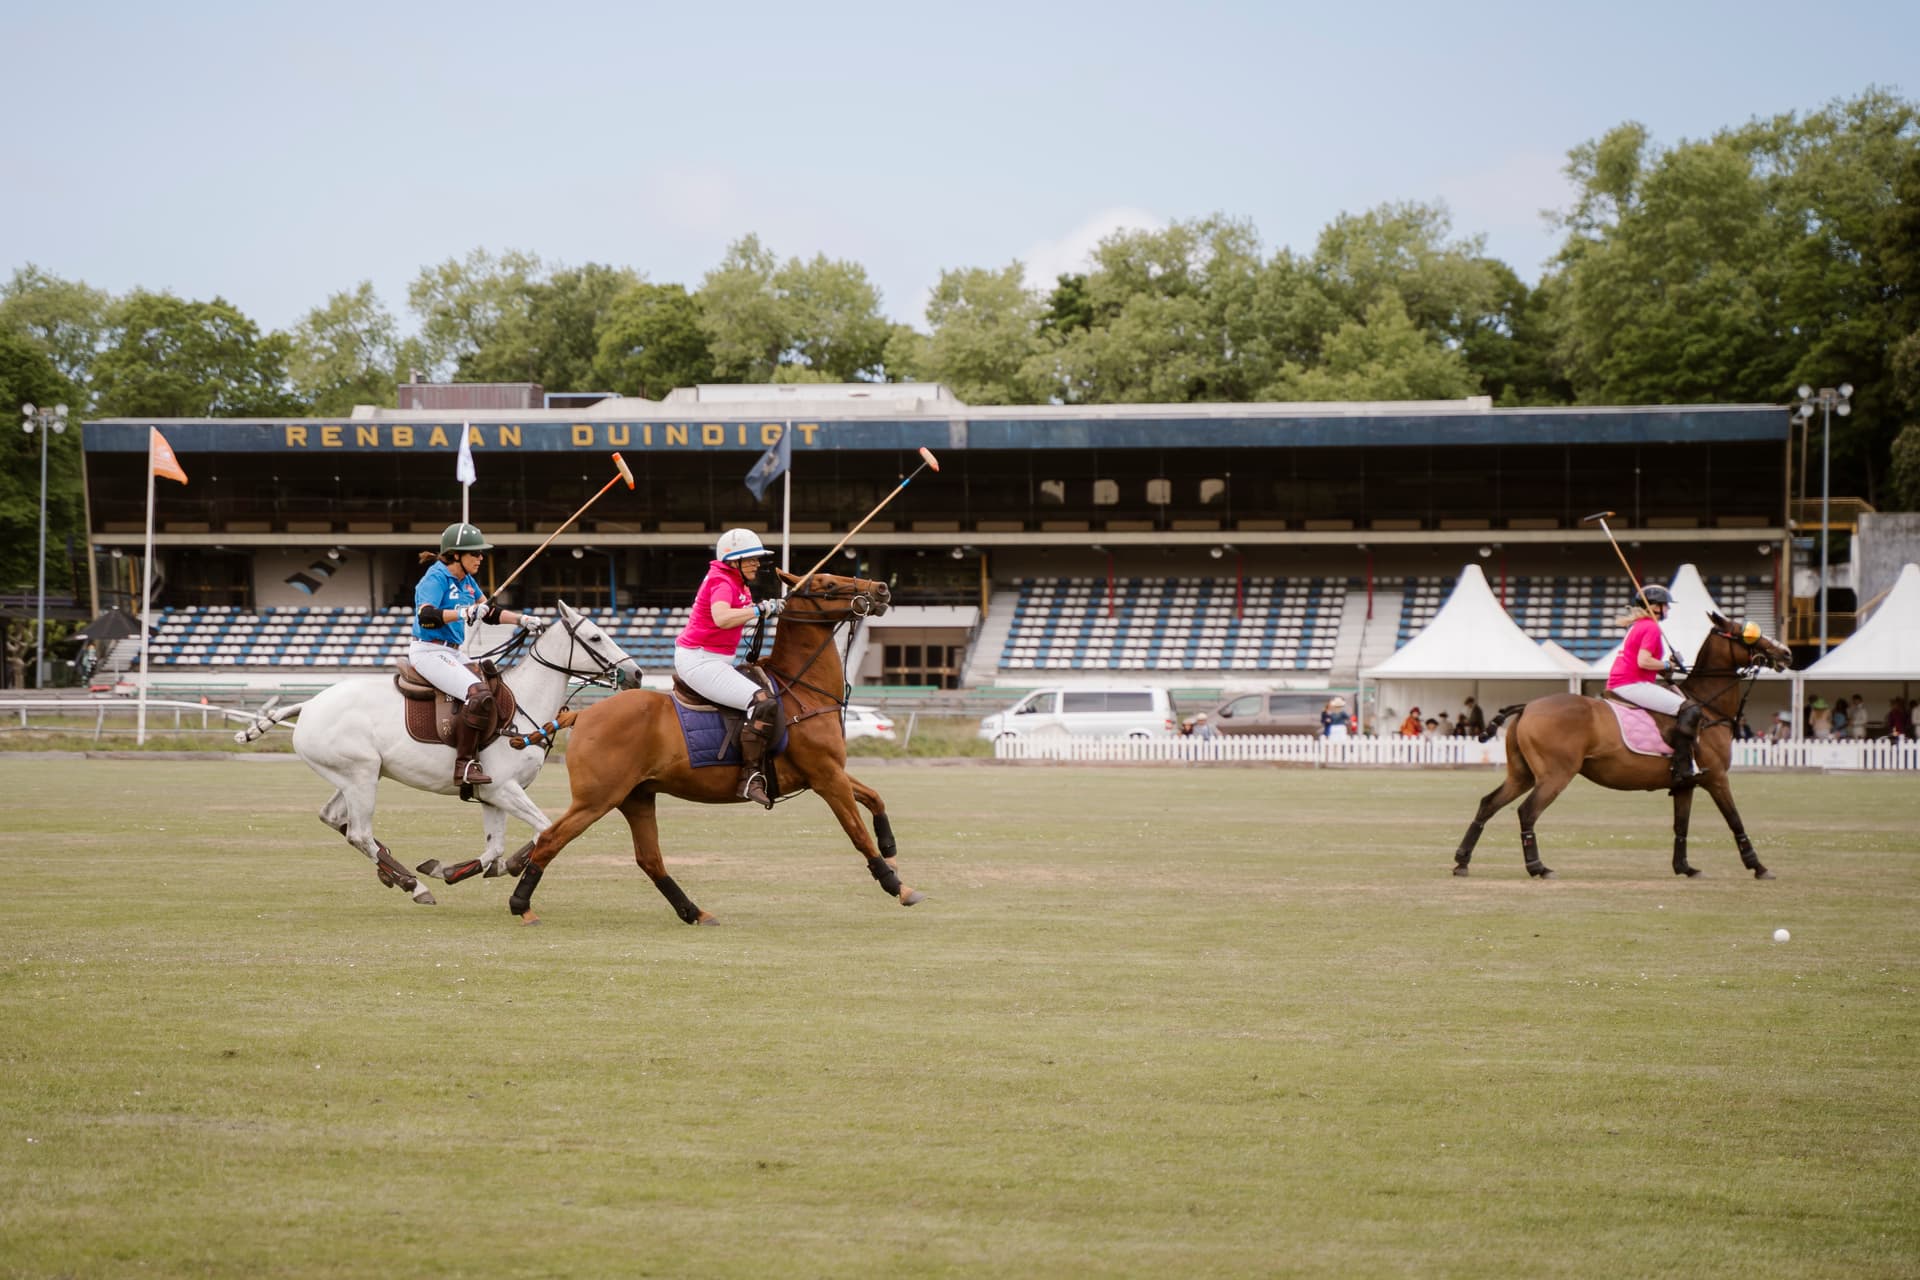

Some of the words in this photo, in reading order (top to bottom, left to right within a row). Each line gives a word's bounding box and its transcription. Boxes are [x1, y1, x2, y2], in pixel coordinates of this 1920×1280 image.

[286, 425, 521, 447] RENBAAN
[571, 424, 819, 446] DUINDIGT
[449, 583, 459, 600] 2
